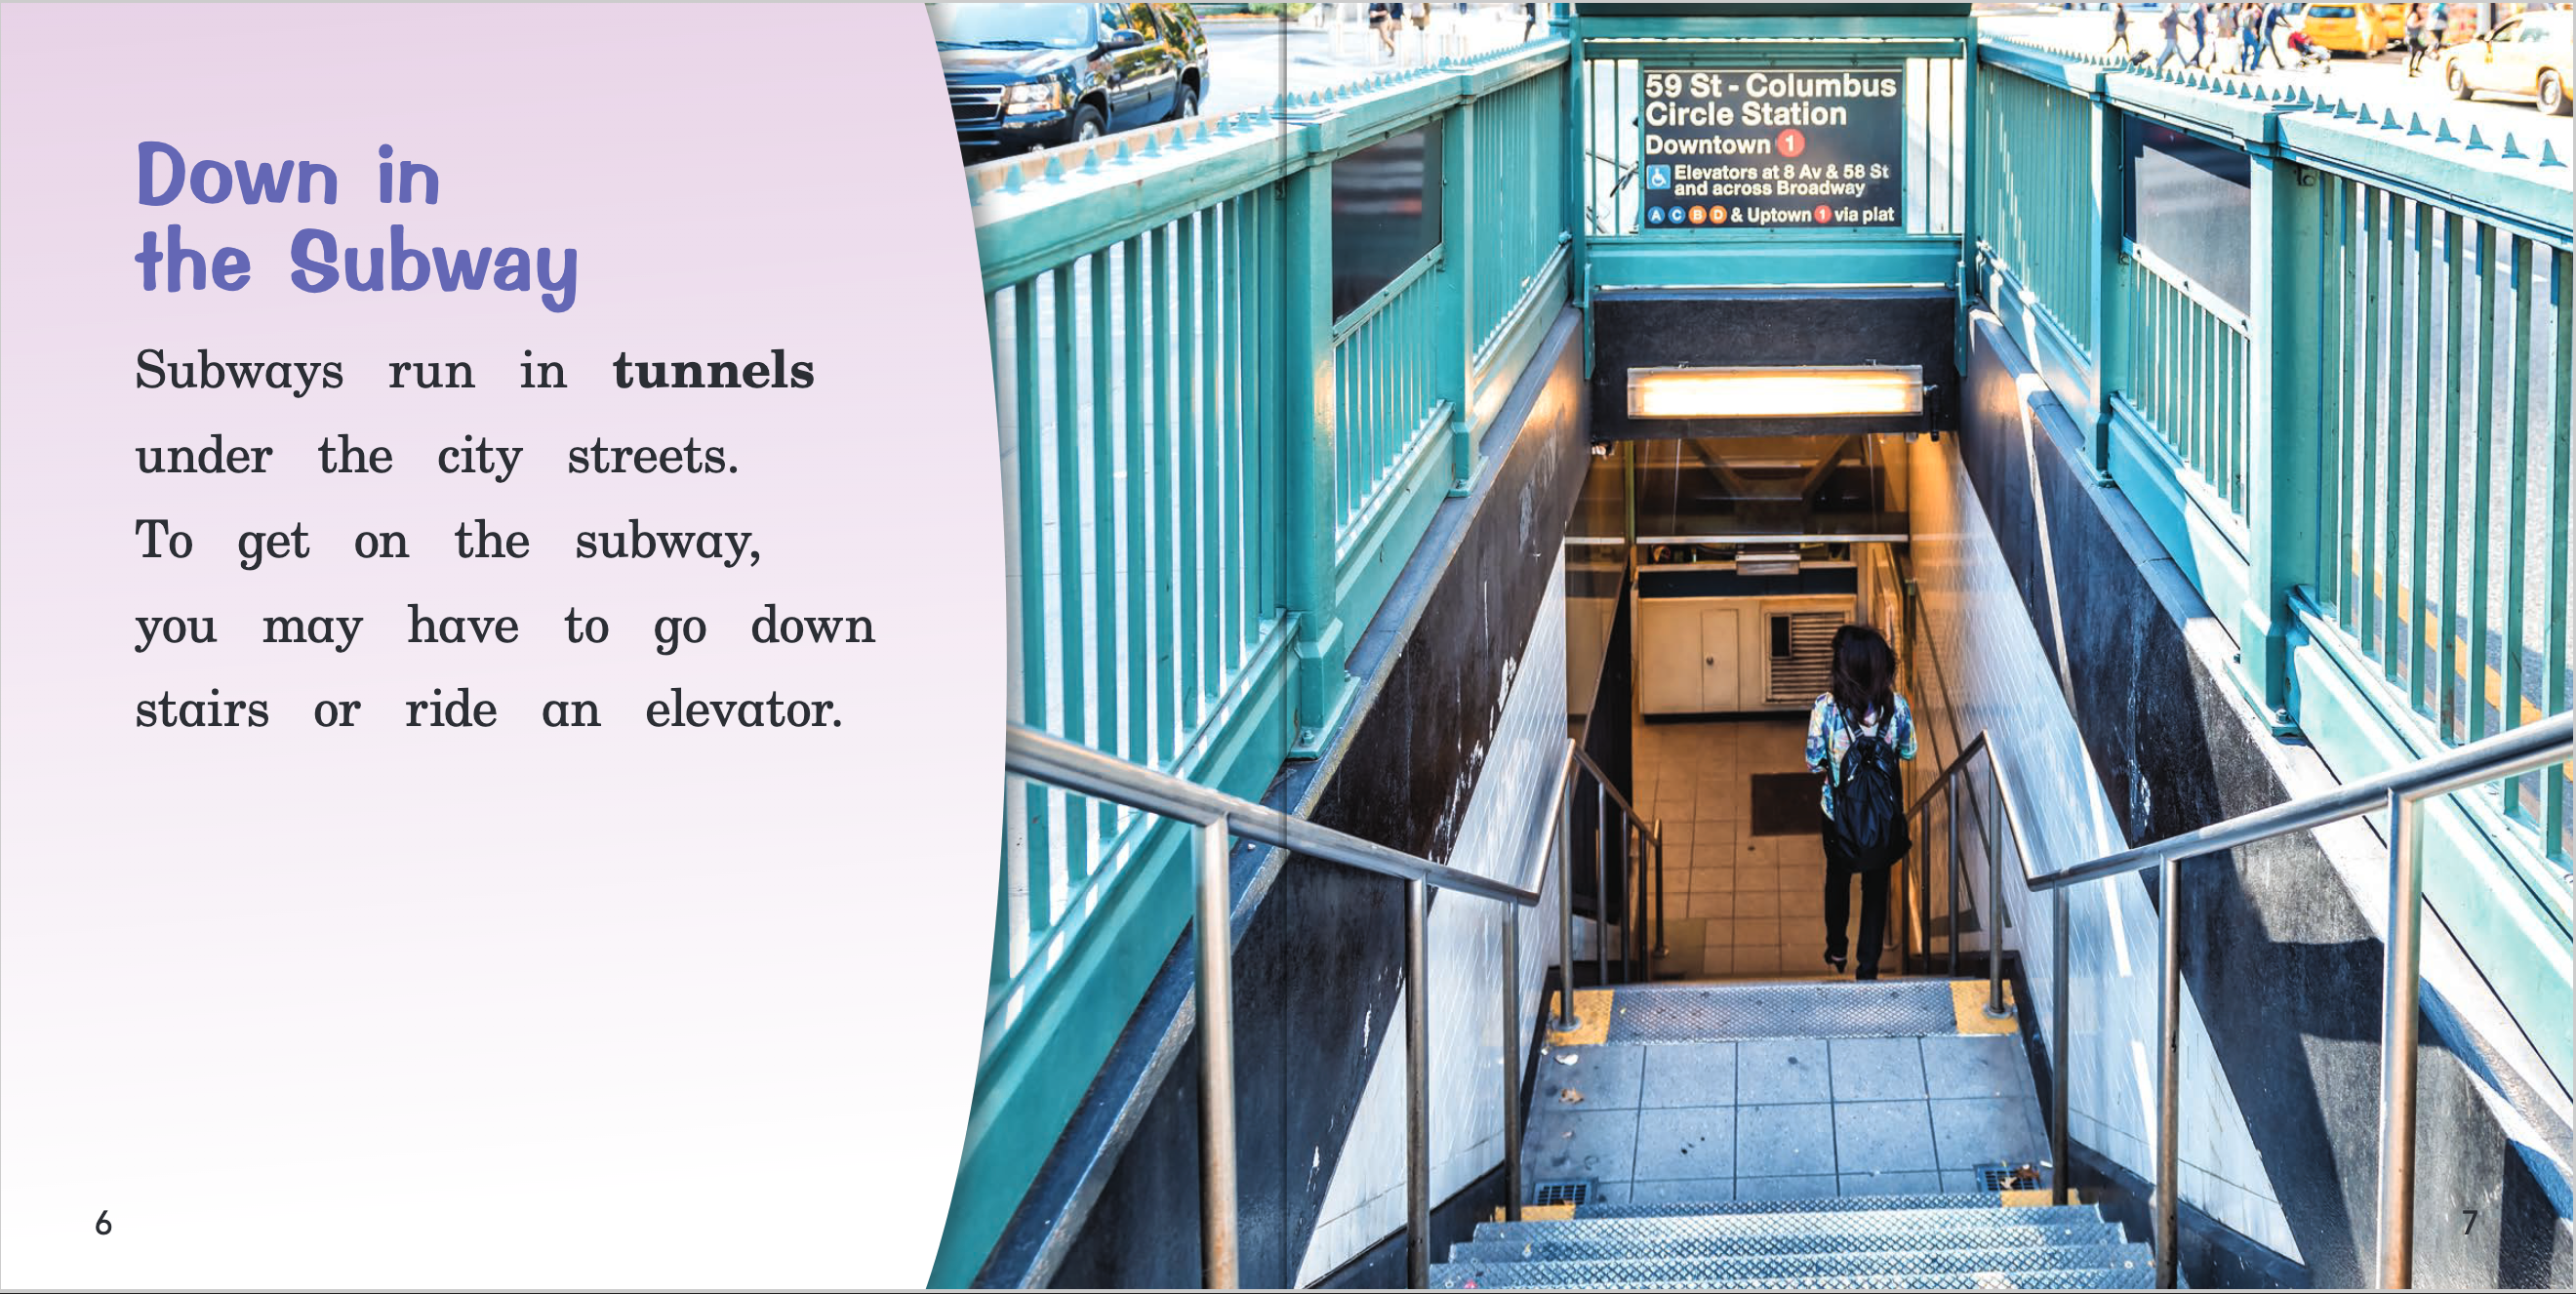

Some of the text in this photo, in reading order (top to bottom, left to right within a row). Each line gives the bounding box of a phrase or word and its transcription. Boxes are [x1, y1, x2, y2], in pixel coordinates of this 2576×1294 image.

[1645, 73, 1897, 98] 59 St - Columbus
[1645, 101, 1847, 126] Circle Station
[1645, 135, 1771, 155] Downtown
[139, 142, 438, 206] Down in
[1673, 164, 1889, 181] Elevators at 8 Av & 58 St
[1674, 180, 1866, 197] and across Broadway
[1730, 208, 1743, 222] &
[1748, 208, 1812, 224] Uptown
[1834, 208, 1858, 222] via
[1862, 207, 1895, 224] plat
[135, 224, 577, 312] the Subway
[137, 348, 814, 398] Subways run in tunnels
[136, 434, 737, 483] under the city streets.
[136, 519, 759, 571] To get on the subway,
[135, 604, 875, 656] you may have to go down
[137, 688, 841, 727] stairs or ride an elevator.
[96, 1210, 111, 1234] 6
[2463, 1210, 2477, 1234] 7
